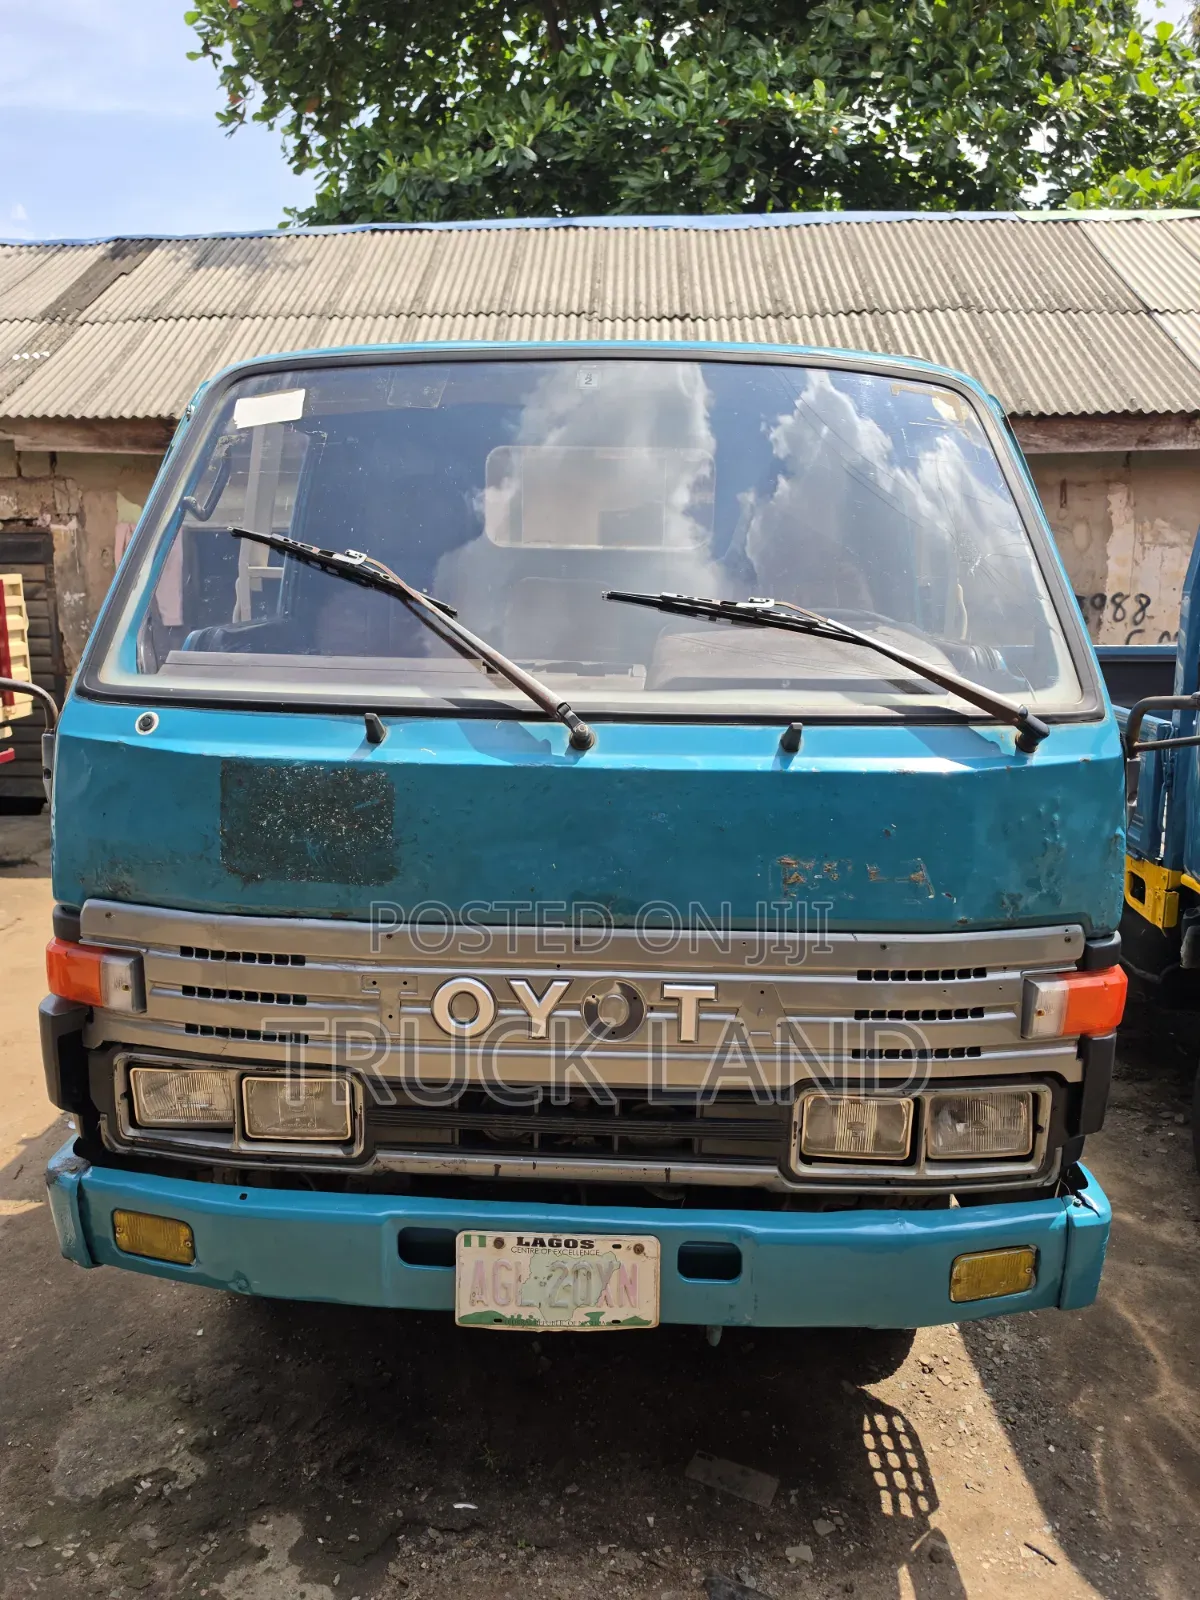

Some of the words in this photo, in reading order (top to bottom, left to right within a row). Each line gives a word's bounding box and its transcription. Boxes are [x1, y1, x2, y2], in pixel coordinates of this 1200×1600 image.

[516, 1236, 595, 1249] LAGOS
[510, 1246, 539, 1255] CENTRE
[541, 1247, 552, 1255] OF
[553, 1248, 600, 1256] EXCELLENCE
